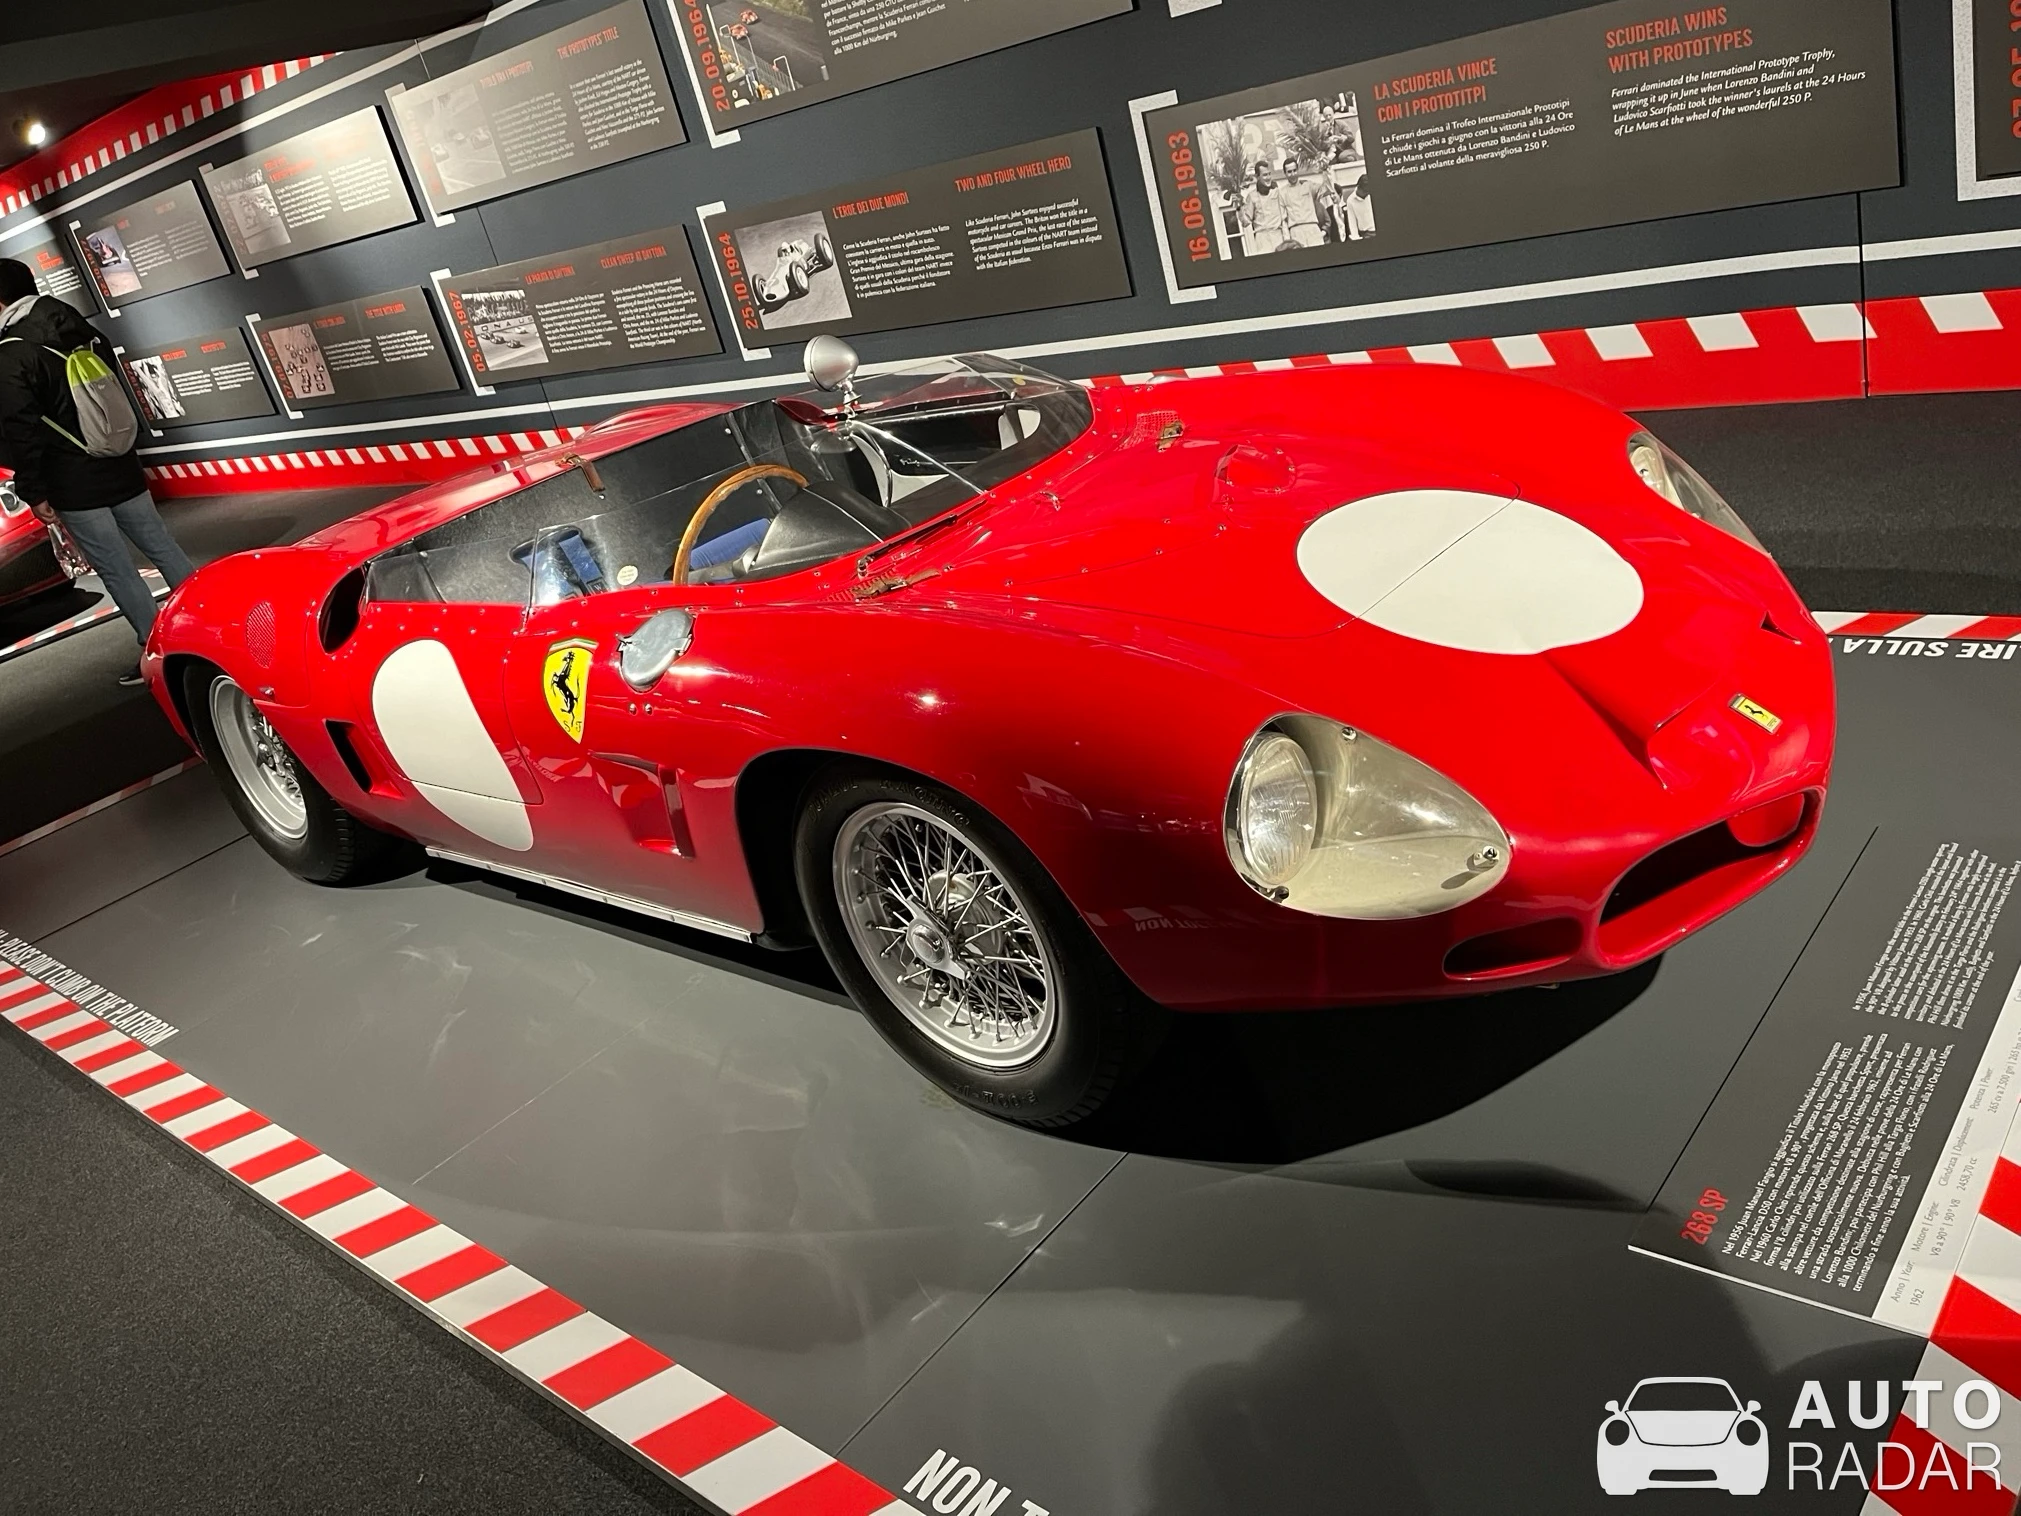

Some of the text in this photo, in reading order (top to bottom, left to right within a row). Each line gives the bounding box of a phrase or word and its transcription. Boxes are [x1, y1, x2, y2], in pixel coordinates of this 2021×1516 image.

[1606, 7, 1727, 48] SCUDERIA WINS
[1608, 29, 1752, 73] WITH PROTOTYPES
[1611, 48, 1835, 98] Ferrari dominated the International Prototype Trophy,
[1374, 58, 1497, 101] LA SCUDERIA VINCE
[1612, 63, 1815, 111] wrapping it up in June when Lorenzo Bandini and
[1613, 71, 1866, 123] Ludovico Scarfiotti took the winner's laurels at the 24 Hours
[1378, 86, 1486, 123] CON I PROTOTITPI
[1381, 100, 1570, 144] La Ferrari domina il Trofeo Internazionale Prototipi
[1614, 91, 1812, 137] of Le Mans at the wheel of the wonderful 250 P.
[1384, 157, 1393, 166] di
[1393, 157, 1402, 165] Le
[1403, 153, 1424, 162] Mans
[1424, 147, 1456, 159] ottenuta
[1457, 143, 1467, 153] da
[1468, 139, 1499, 150] Lorenzo
[1500, 132, 1531, 144] Bandini
[1538, 124, 1575, 137] Ludovico
[1388, 142, 1413, 154] chiude
[1417, 137, 1440, 151] giochi
[1447, 132, 1474, 145] giugno
[1474, 128, 1489, 137] con
[1490, 125, 1498, 134] la
[1499, 121, 1527, 132] vittoria
[1528, 116, 1544, 127] alla
[1545, 113, 1556, 123] 24
[1557, 111, 1574, 121] Ore
[955, 156, 1072, 192] TWO AND FOUR WHEEL HERO
[1386, 139, 1549, 178] Scarfiotti al volante della meravigliosa 250 P.
[856, 201, 870, 214] DEI
[868, 197, 885, 211] DUE
[883, 192, 909, 208] MONDI
[1168, 130, 1211, 262] 16.06.1963
[718, 232, 758, 330] 25.10.1964
[449, 291, 486, 372] 05.02.1967
[1843, 637, 2021, 660] IRE SULLA
[0, 937, 180, 1047] PLEASE DON'T CLIMB ON THE PLATFORM
[1681, 1189, 1729, 1245] 268 SP
[902, 1448, 1012, 1516] NON
